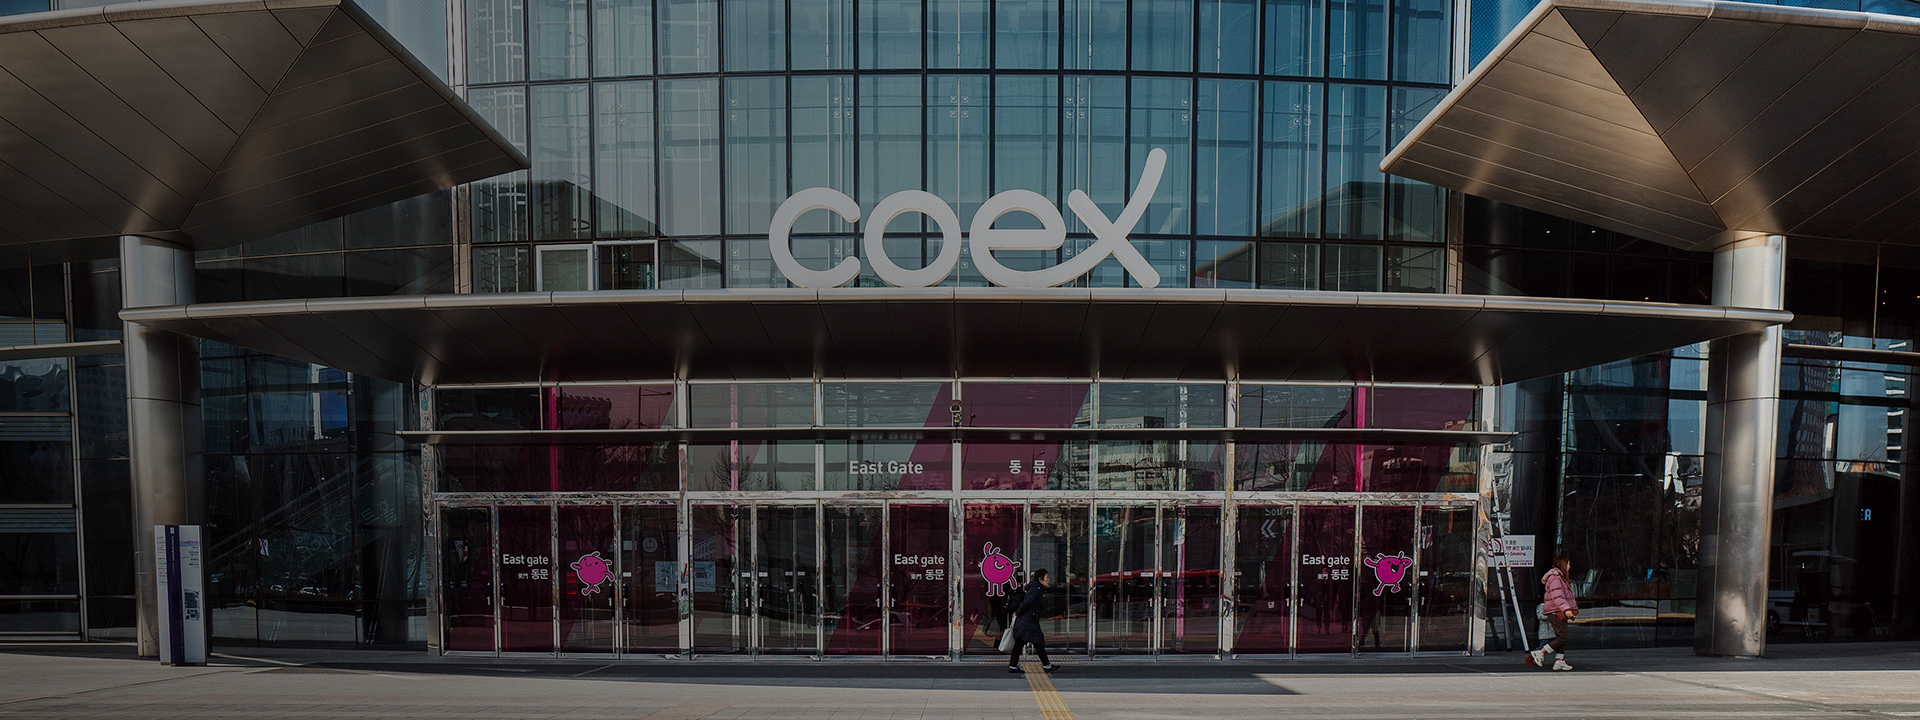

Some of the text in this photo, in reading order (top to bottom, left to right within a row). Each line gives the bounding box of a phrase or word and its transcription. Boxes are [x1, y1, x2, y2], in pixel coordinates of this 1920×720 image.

[769, 147, 1167, 289] coex
[849, 460, 924, 475] East Gate
[503, 554, 549, 567] East gate
[894, 554, 945, 568] East gate
[1302, 554, 1350, 568] East gate
[531, 568, 549, 580] 동문
[925, 568, 945, 581] 동문
[1331, 568, 1349, 581] 동문
